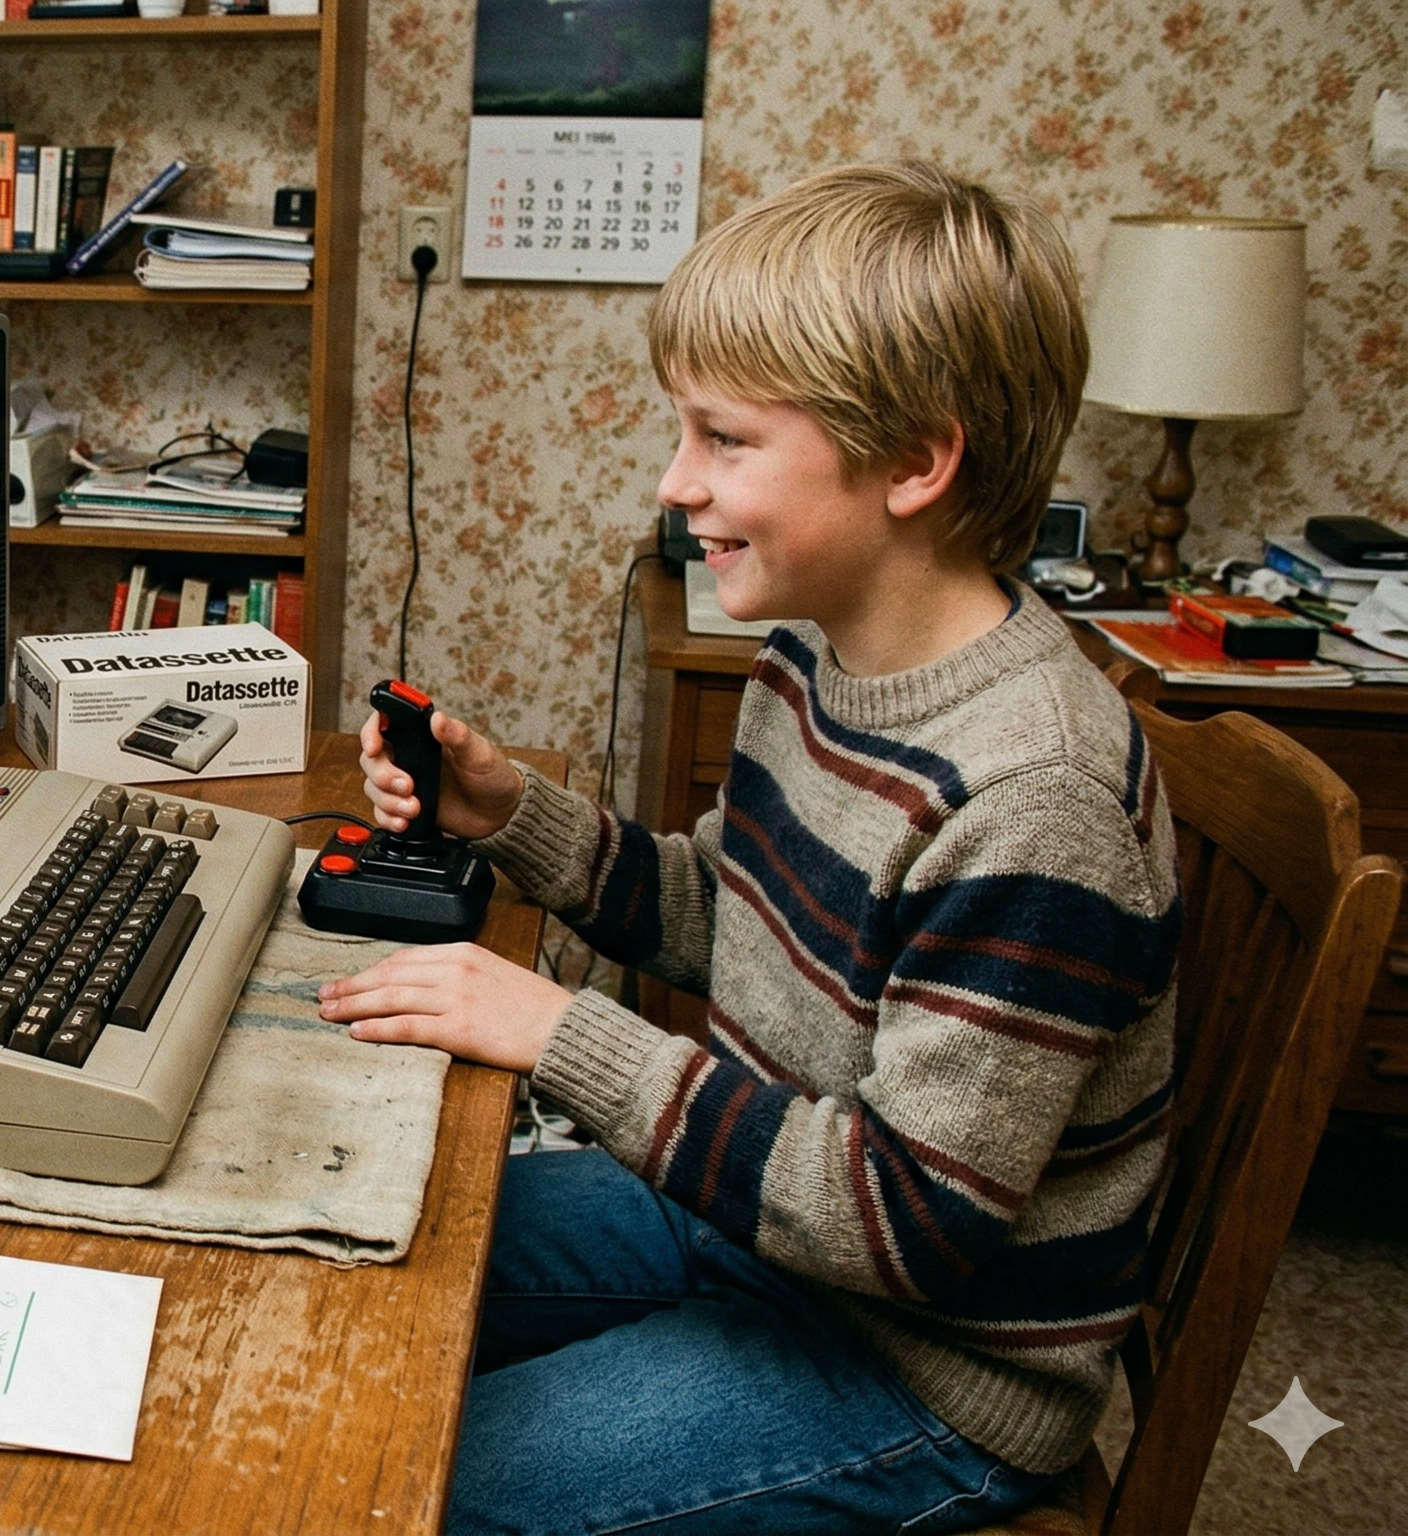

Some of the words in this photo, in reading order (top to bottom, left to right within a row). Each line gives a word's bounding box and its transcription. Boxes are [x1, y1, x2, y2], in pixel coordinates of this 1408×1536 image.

[616, 162, 623, 173] 1
[644, 162, 653, 174] 2
[674, 163, 683, 175] 3
[497, 179, 506, 190] 4
[527, 180, 534, 191] 5
[555, 181, 563, 191] 6
[584, 181, 592, 191] 7
[613, 181, 622, 193] 8
[643, 182, 652, 193] 9
[665, 182, 683, 195] 10
[518, 198, 534, 210] 12
[547, 198, 563, 212] 13
[576, 199, 592, 212] 14
[605, 200, 622, 213] 15
[634, 200, 651, 213] 16
[663, 201, 680, 214] 17
[488, 215, 505, 229] 18
[517, 216, 534, 229] 19
[544, 217, 563, 230] 20
[573, 217, 590, 230] 21
[601, 218, 621, 232] 22
[631, 219, 650, 233] 23
[660, 219, 679, 233] 24
[484, 235, 504, 248] 25
[514, 235, 533, 248] 26
[542, 236, 562, 249] 27
[571, 236, 591, 250] 28
[600, 237, 620, 250] 29
[630, 238, 649, 251] 30
[61, 647, 288, 674] Datassette
[186, 676, 299, 703] Datassette
